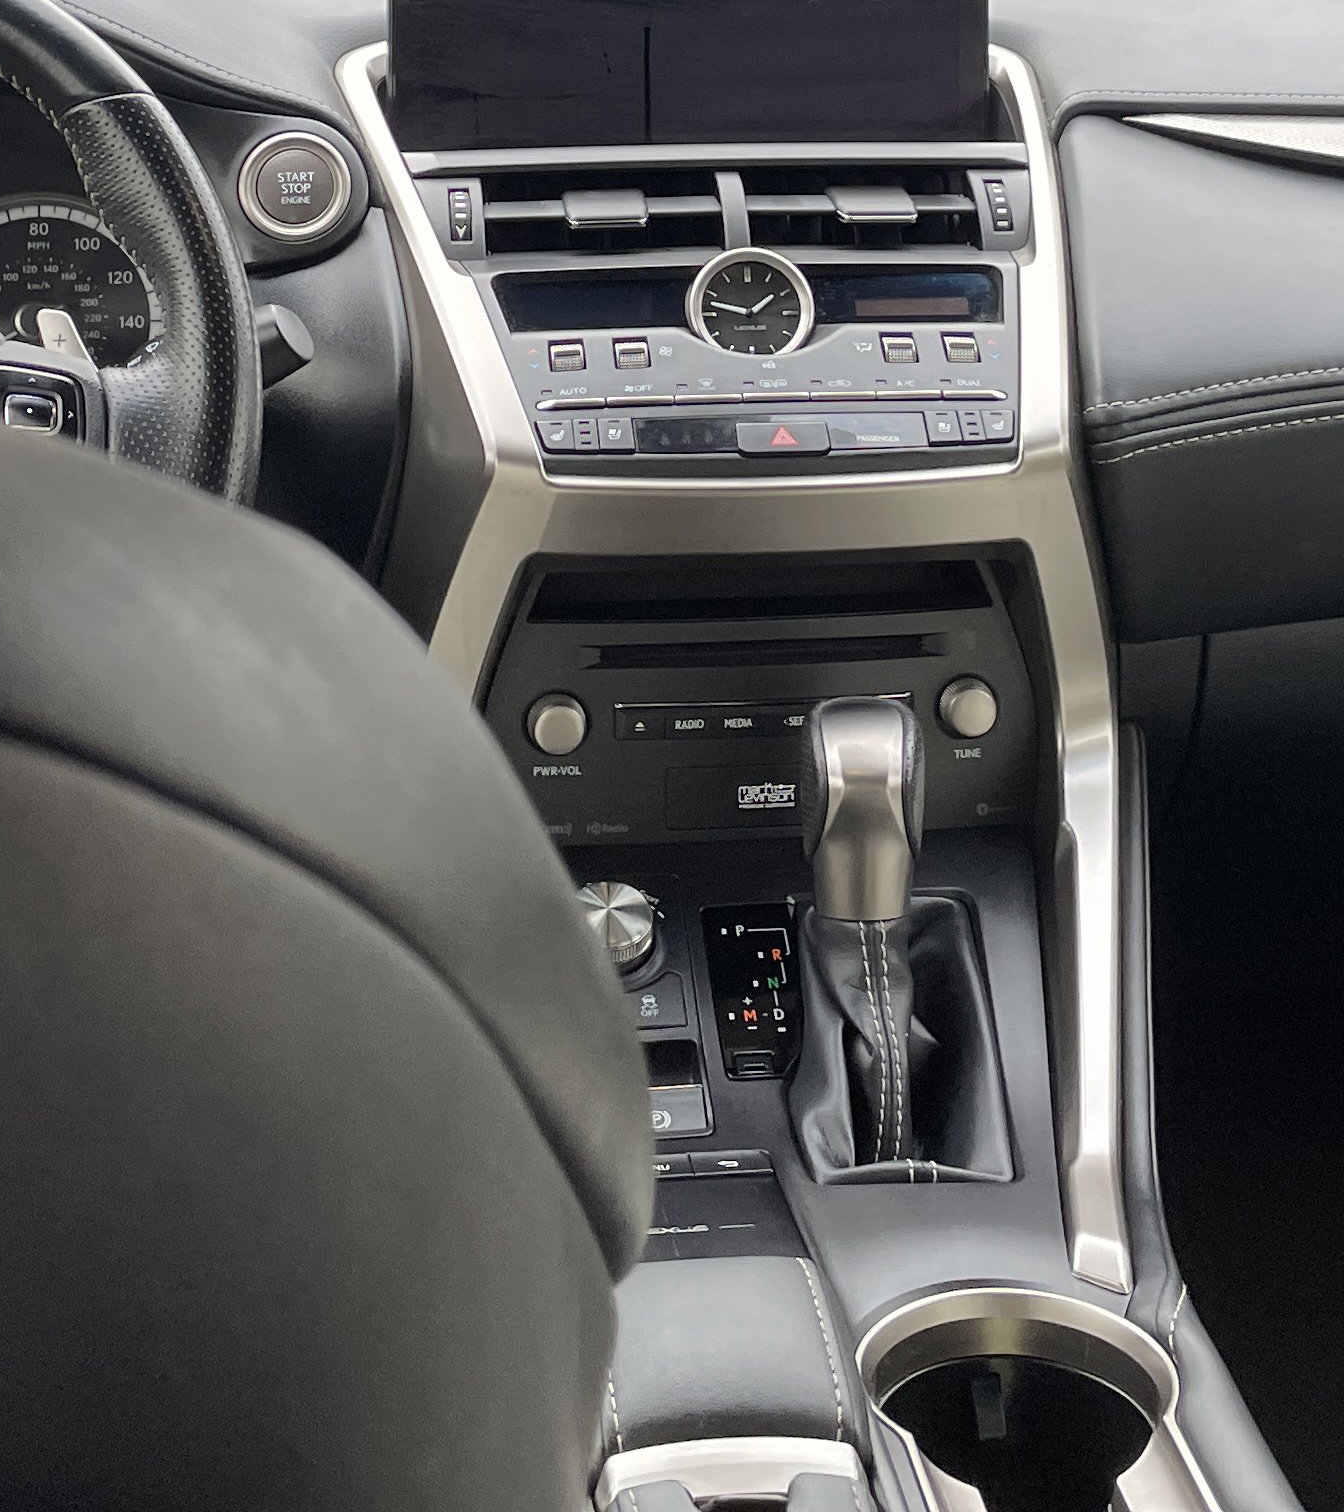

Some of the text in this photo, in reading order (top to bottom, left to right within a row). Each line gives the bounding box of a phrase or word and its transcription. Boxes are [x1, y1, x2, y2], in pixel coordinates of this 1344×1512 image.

[277, 171, 315, 183] START
[281, 183, 312, 194] STOP
[280, 195, 312, 205] ENGINE
[29, 222, 50, 236] 80
[27, 242, 51, 251] MPH
[74, 237, 101, 251] 100
[22, 265, 38, 274] 120
[43, 264, 59, 273] 140
[2, 273, 19, 281] 100
[61, 272, 77, 281] 160
[107, 270, 133, 285] 120
[27, 281, 51, 291] km/h
[74, 284, 91, 293] 180
[80, 298, 98, 307] 200
[84, 314, 102, 322] 220
[119, 315, 145, 329] 140
[83, 330, 101, 339] 240
[896, 379, 915, 388] A/C
[956, 378, 983, 387] DUAL
[559, 386, 588, 396] AUTO
[632, 384, 654, 393] OFF
[856, 434, 901, 443] PASSENGER
[674, 719, 705, 730] RADIO
[724, 718, 753, 729] MEDIA
[953, 747, 982, 759] TUNE
[735, 924, 745, 937] P
[771, 948, 783, 962] R
[767, 976, 780, 989] N
[640, 1008, 660, 1017] OFF
[742, 1008, 785, 1023] M D
